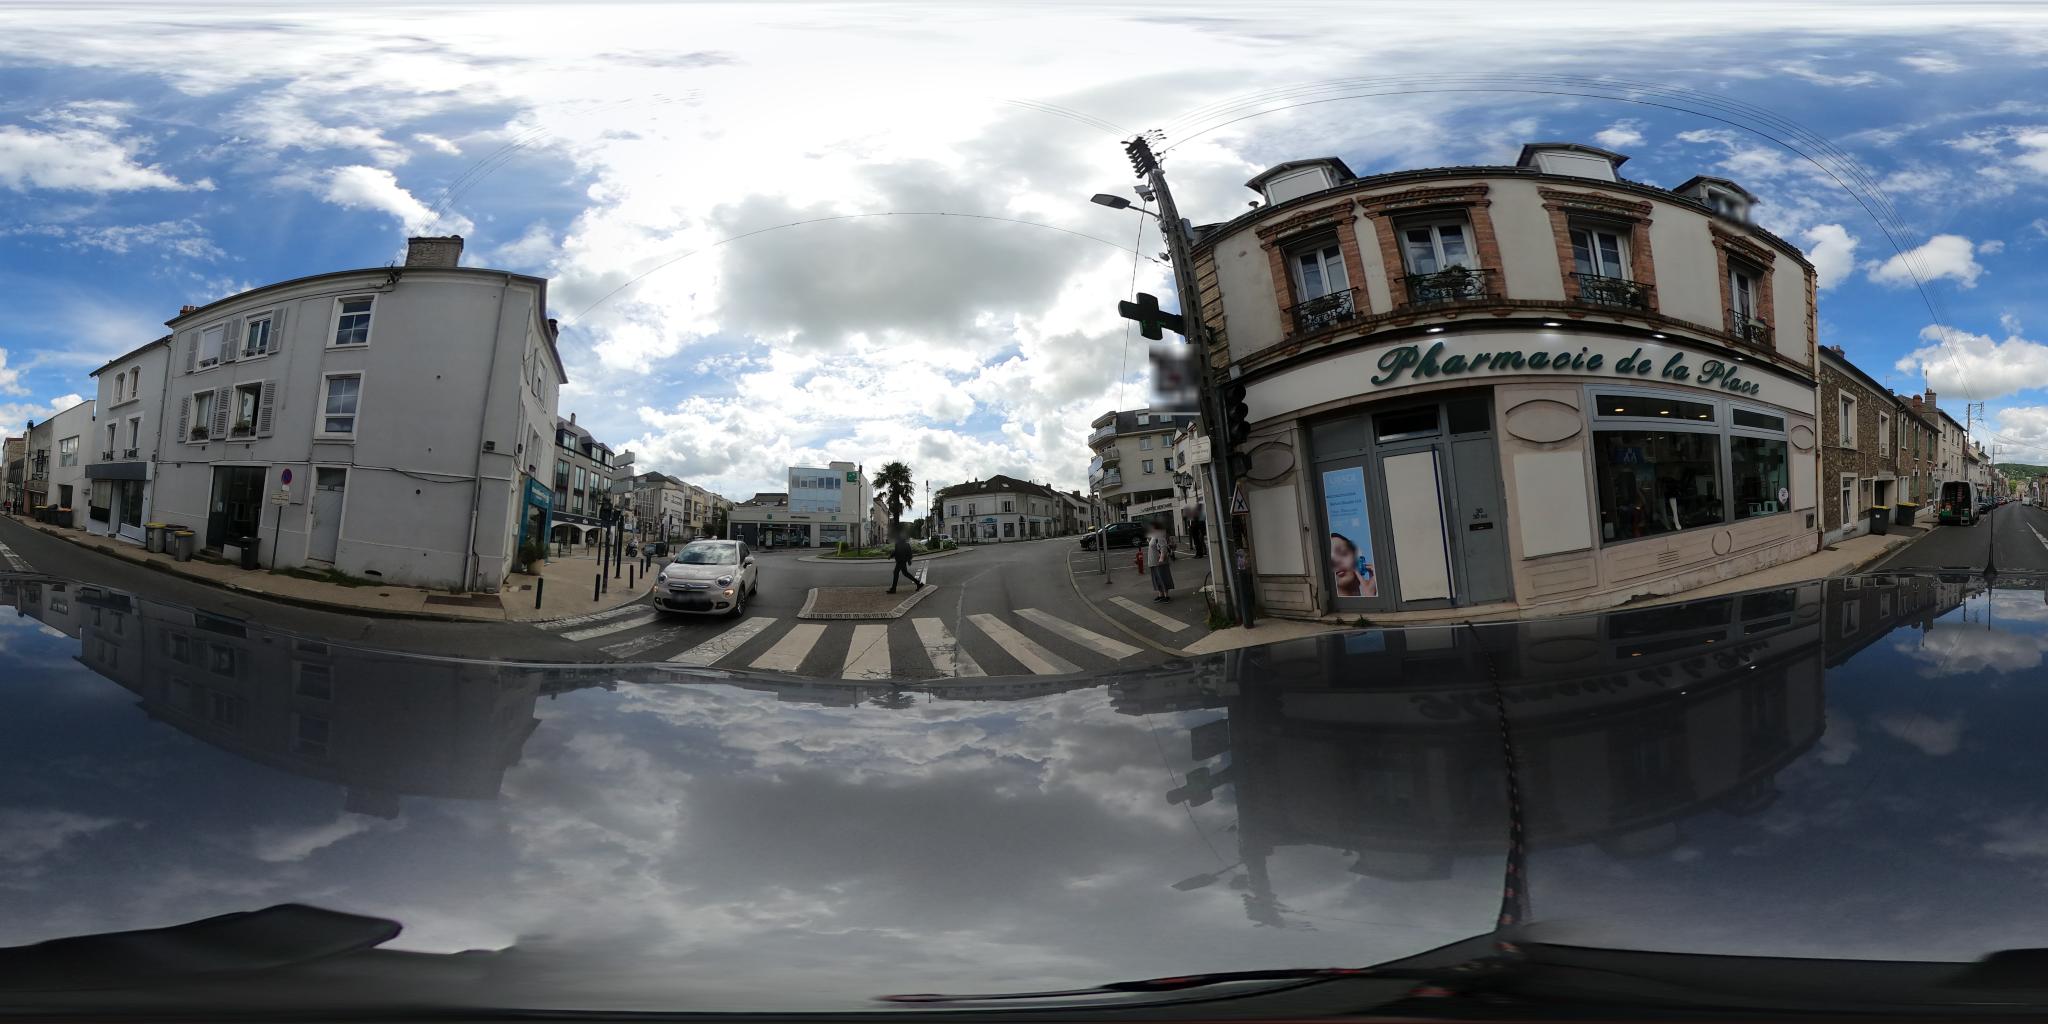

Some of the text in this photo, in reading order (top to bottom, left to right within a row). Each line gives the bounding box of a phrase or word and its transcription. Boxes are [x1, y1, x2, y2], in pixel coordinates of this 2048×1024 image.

[1370, 341, 1760, 395] Pharmacie de la Place
